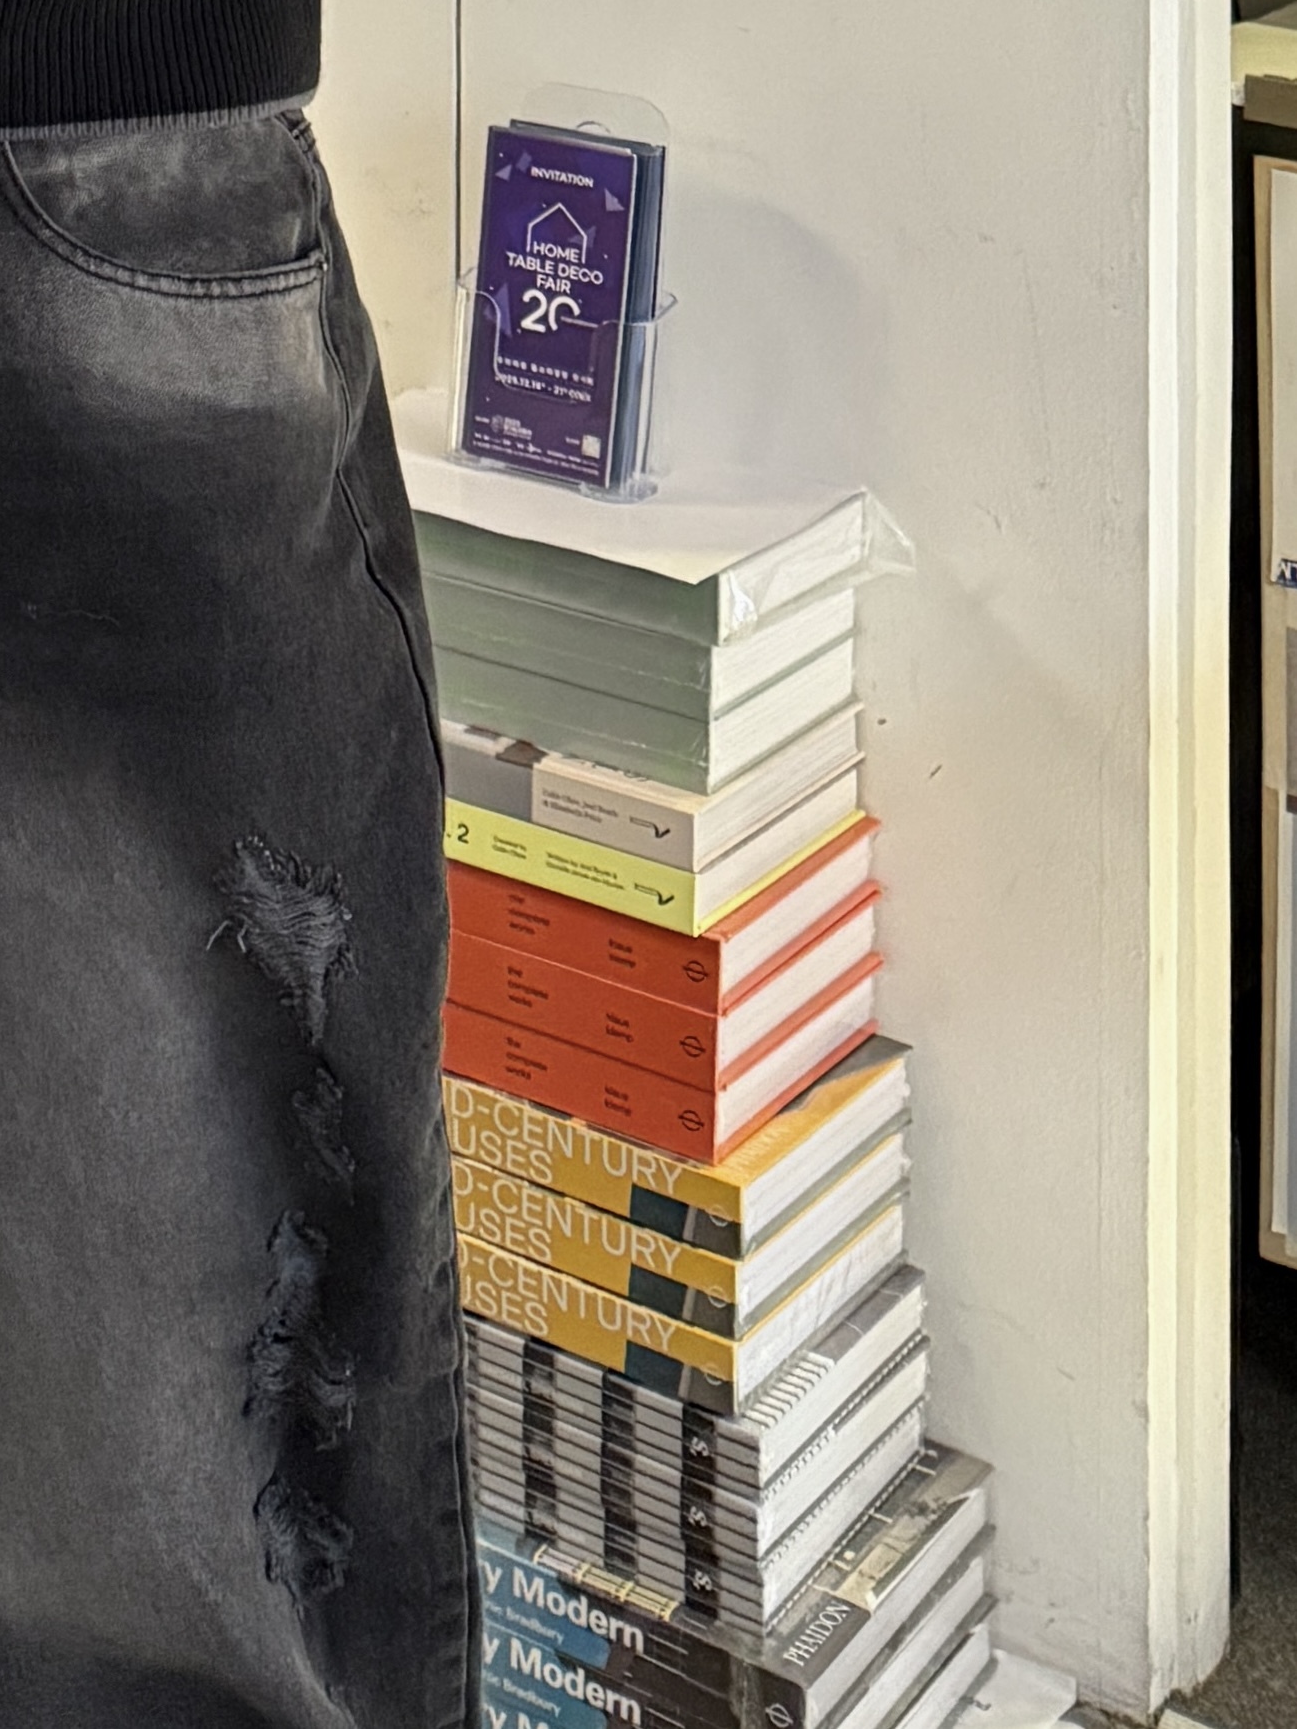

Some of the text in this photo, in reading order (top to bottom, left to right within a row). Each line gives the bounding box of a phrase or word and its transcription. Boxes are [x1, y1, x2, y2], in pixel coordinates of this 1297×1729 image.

[530, 165, 594, 188] INVITATION
[533, 240, 580, 263] HOME
[505, 251, 604, 286] TABLE DECO
[536, 274, 572, 295] FAIR
[456, 823, 470, 844] 2
[511, 1565, 645, 1656] Modern
[782, 1601, 852, 1668] PHAIDON
[509, 1636, 643, 1726] Modern
